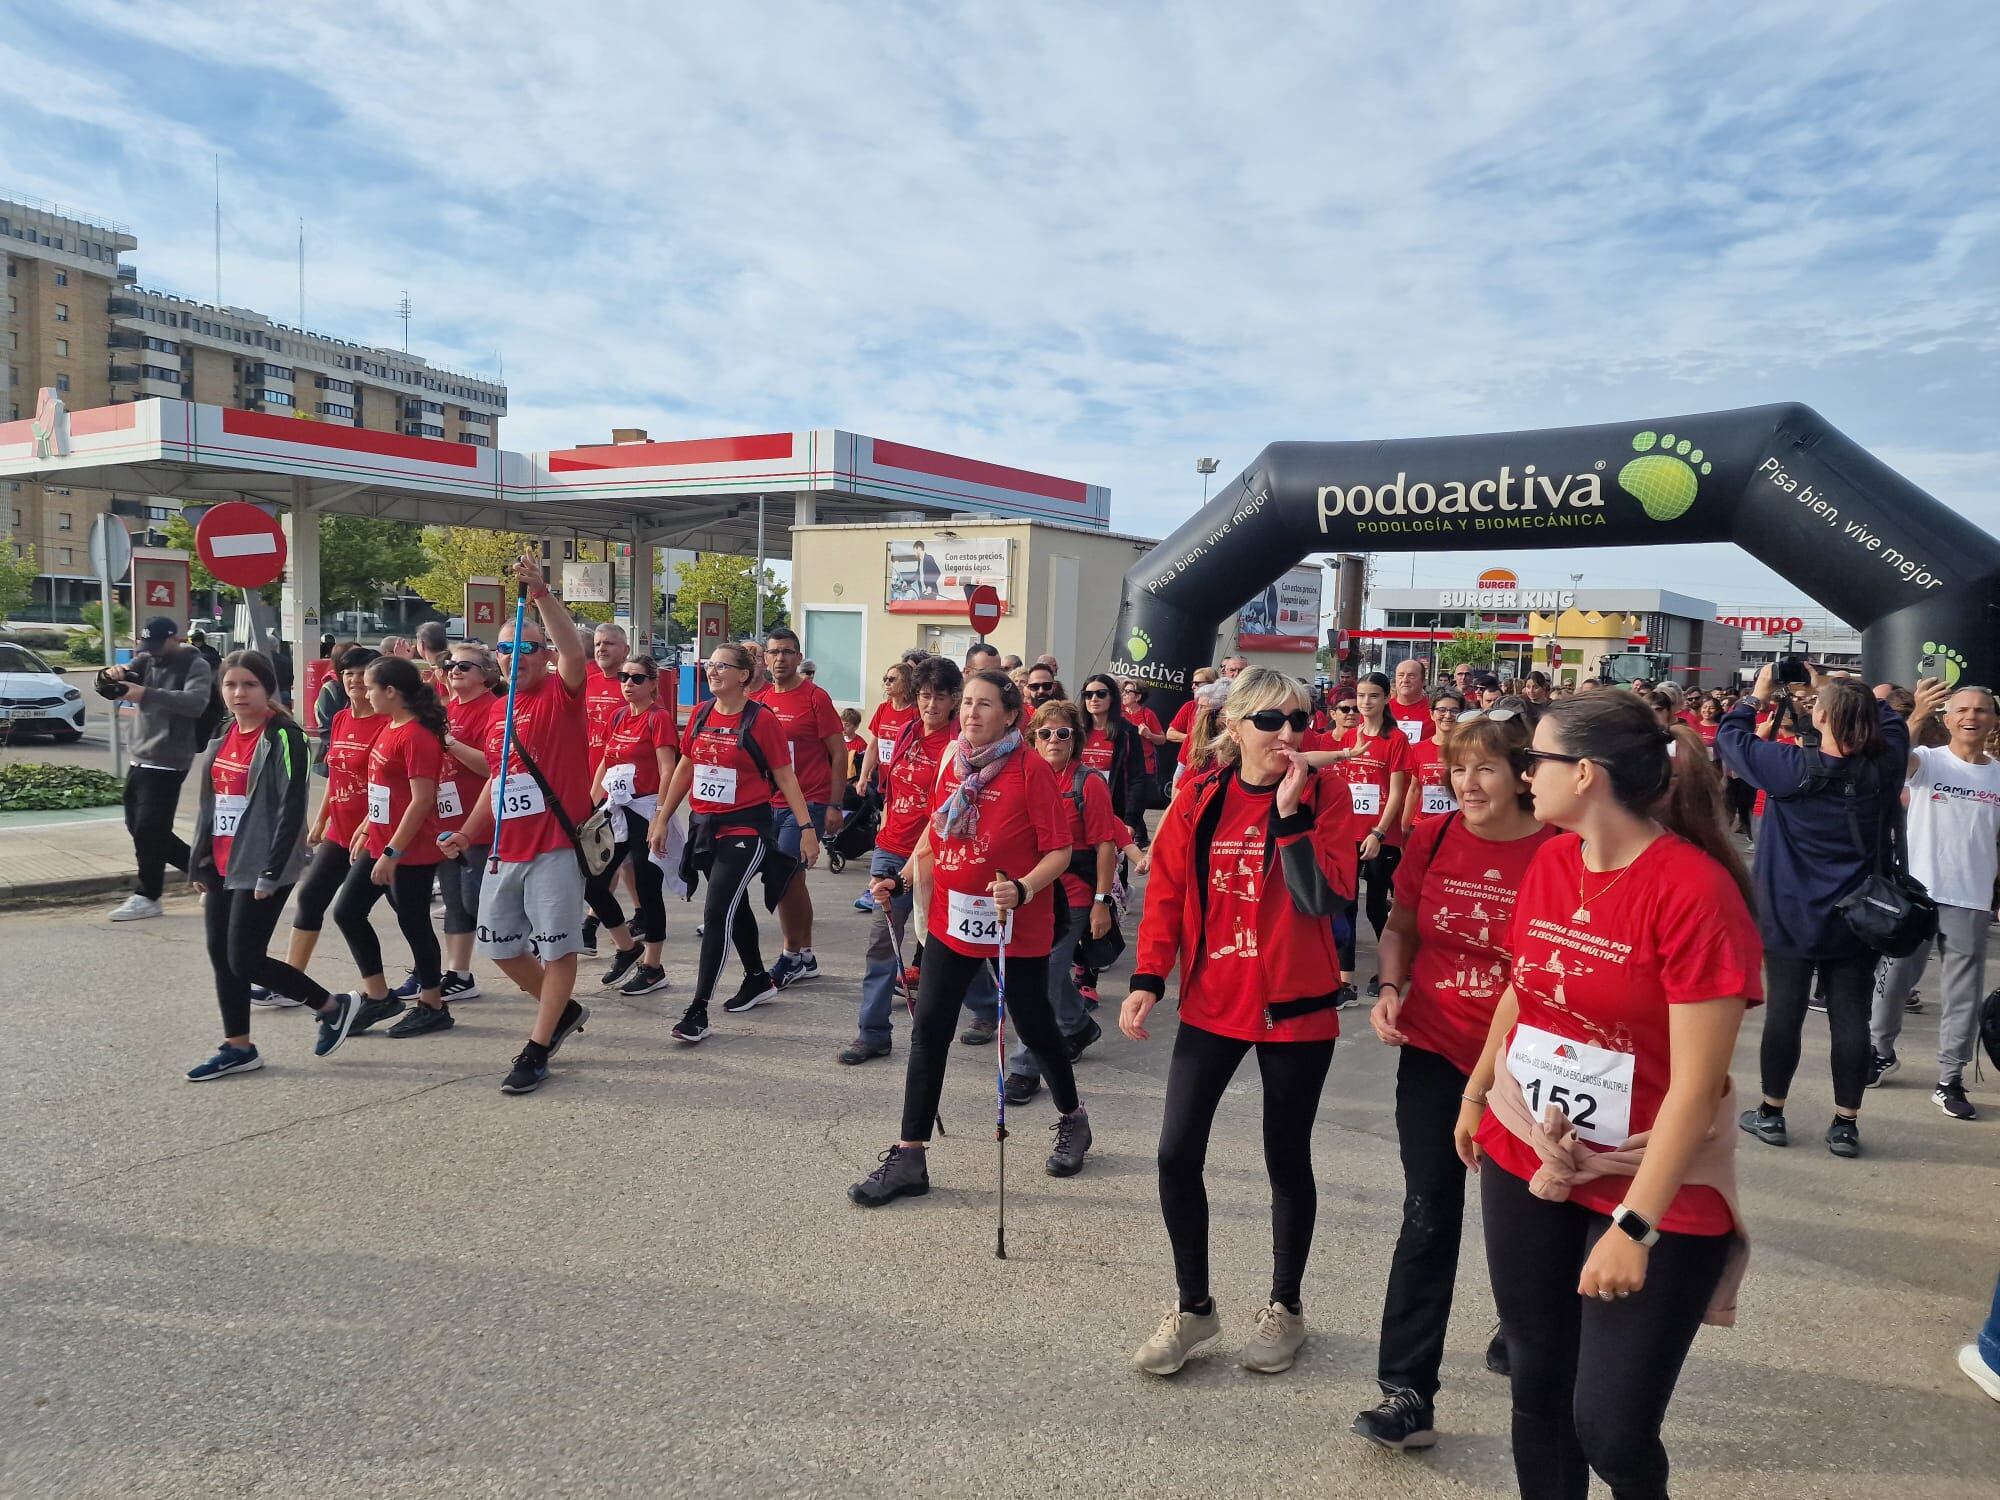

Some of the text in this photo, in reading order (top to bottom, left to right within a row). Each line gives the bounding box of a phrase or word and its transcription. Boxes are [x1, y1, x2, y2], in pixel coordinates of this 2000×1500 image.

[1317, 465, 1605, 534] podoactiva
[1357, 512, 1607, 533] PODOLOGÍA Y BIOMECÁNICA
[1758, 456, 1944, 590] Pisa bien, vive mejor
[1147, 488, 1270, 595] Pisa bien, vive mejor
[945, 552, 957, 561] Con
[959, 553, 977, 561] estos
[944, 563, 993, 573] llegarás lejos.
[1478, 581, 1517, 590] BURGER
[1439, 591, 1575, 608] BURGER KING
[1108, 657, 1185, 684] odoactiva
[608, 779, 627, 793] 136
[700, 782, 726, 798] 267
[439, 800, 452, 814] 06
[1354, 799, 1370, 810] 05
[1429, 799, 1451, 810] 201
[215, 815, 236, 831] 137
[1444, 886, 1454, 894] LA
[1455, 888, 1500, 902] ESCLEROSIS
[1449, 879, 1482, 890] MARCHA
[1483, 884, 1518, 897] SOLIDAR
[959, 918, 998, 938] 434
[1535, 919, 1567, 935] MARCHA
[1567, 929, 1610, 948] SOLIDARIA
[1610, 941, 1632, 954] POR
[1527, 928, 1626, 964] LA ESCLEROSIS MÚLTIPLE
[1552, 1064, 1564, 1075] POR
[1563, 1068, 1570, 1078] LA
[1570, 1070, 1602, 1086] ESCLEROSIS
[1526, 1078, 1597, 1130] 152
